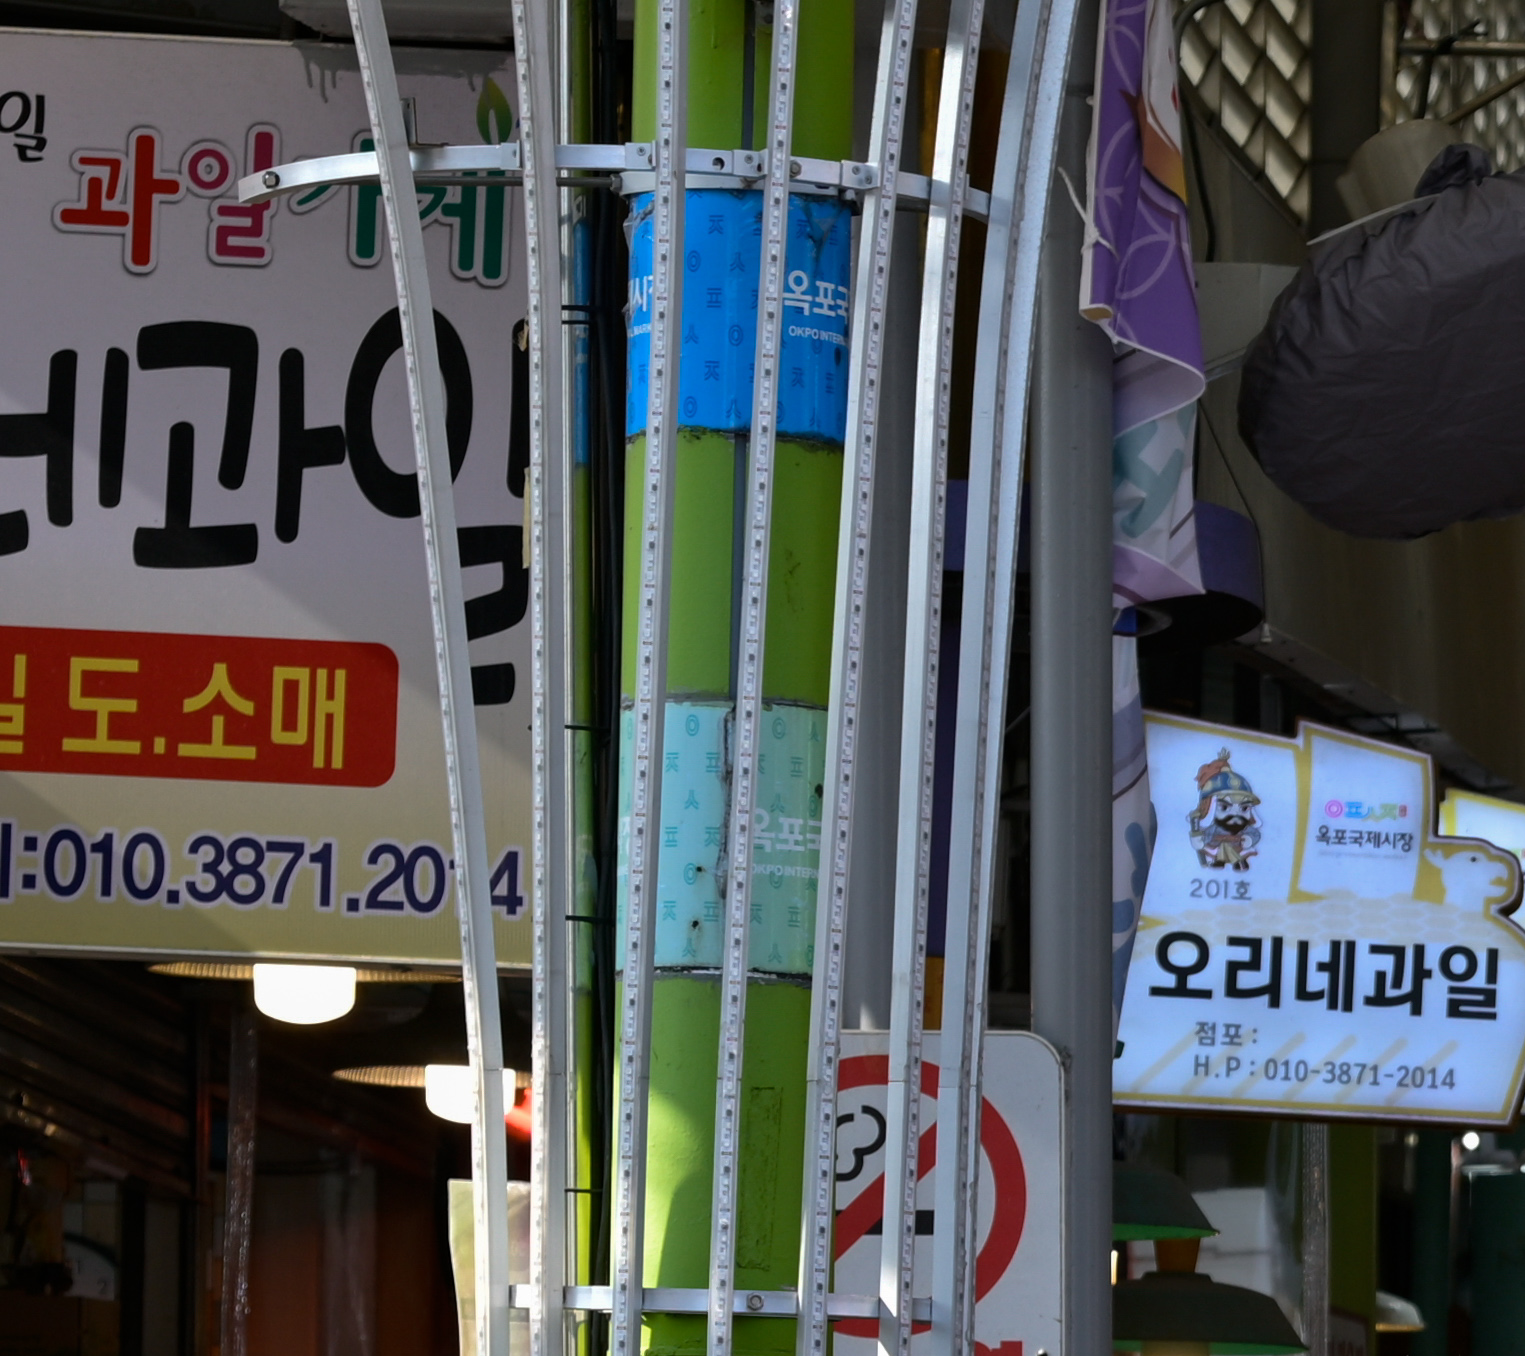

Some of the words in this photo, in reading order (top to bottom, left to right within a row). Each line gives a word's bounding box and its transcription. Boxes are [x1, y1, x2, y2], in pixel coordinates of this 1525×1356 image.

[1315, 825, 1414, 853] 옥포국제시장
[1188, 878, 1253, 902] 201호
[1148, 930, 1500, 1021] 오리네과일
[1263, 1058, 1457, 1092] 010-3871-2014
